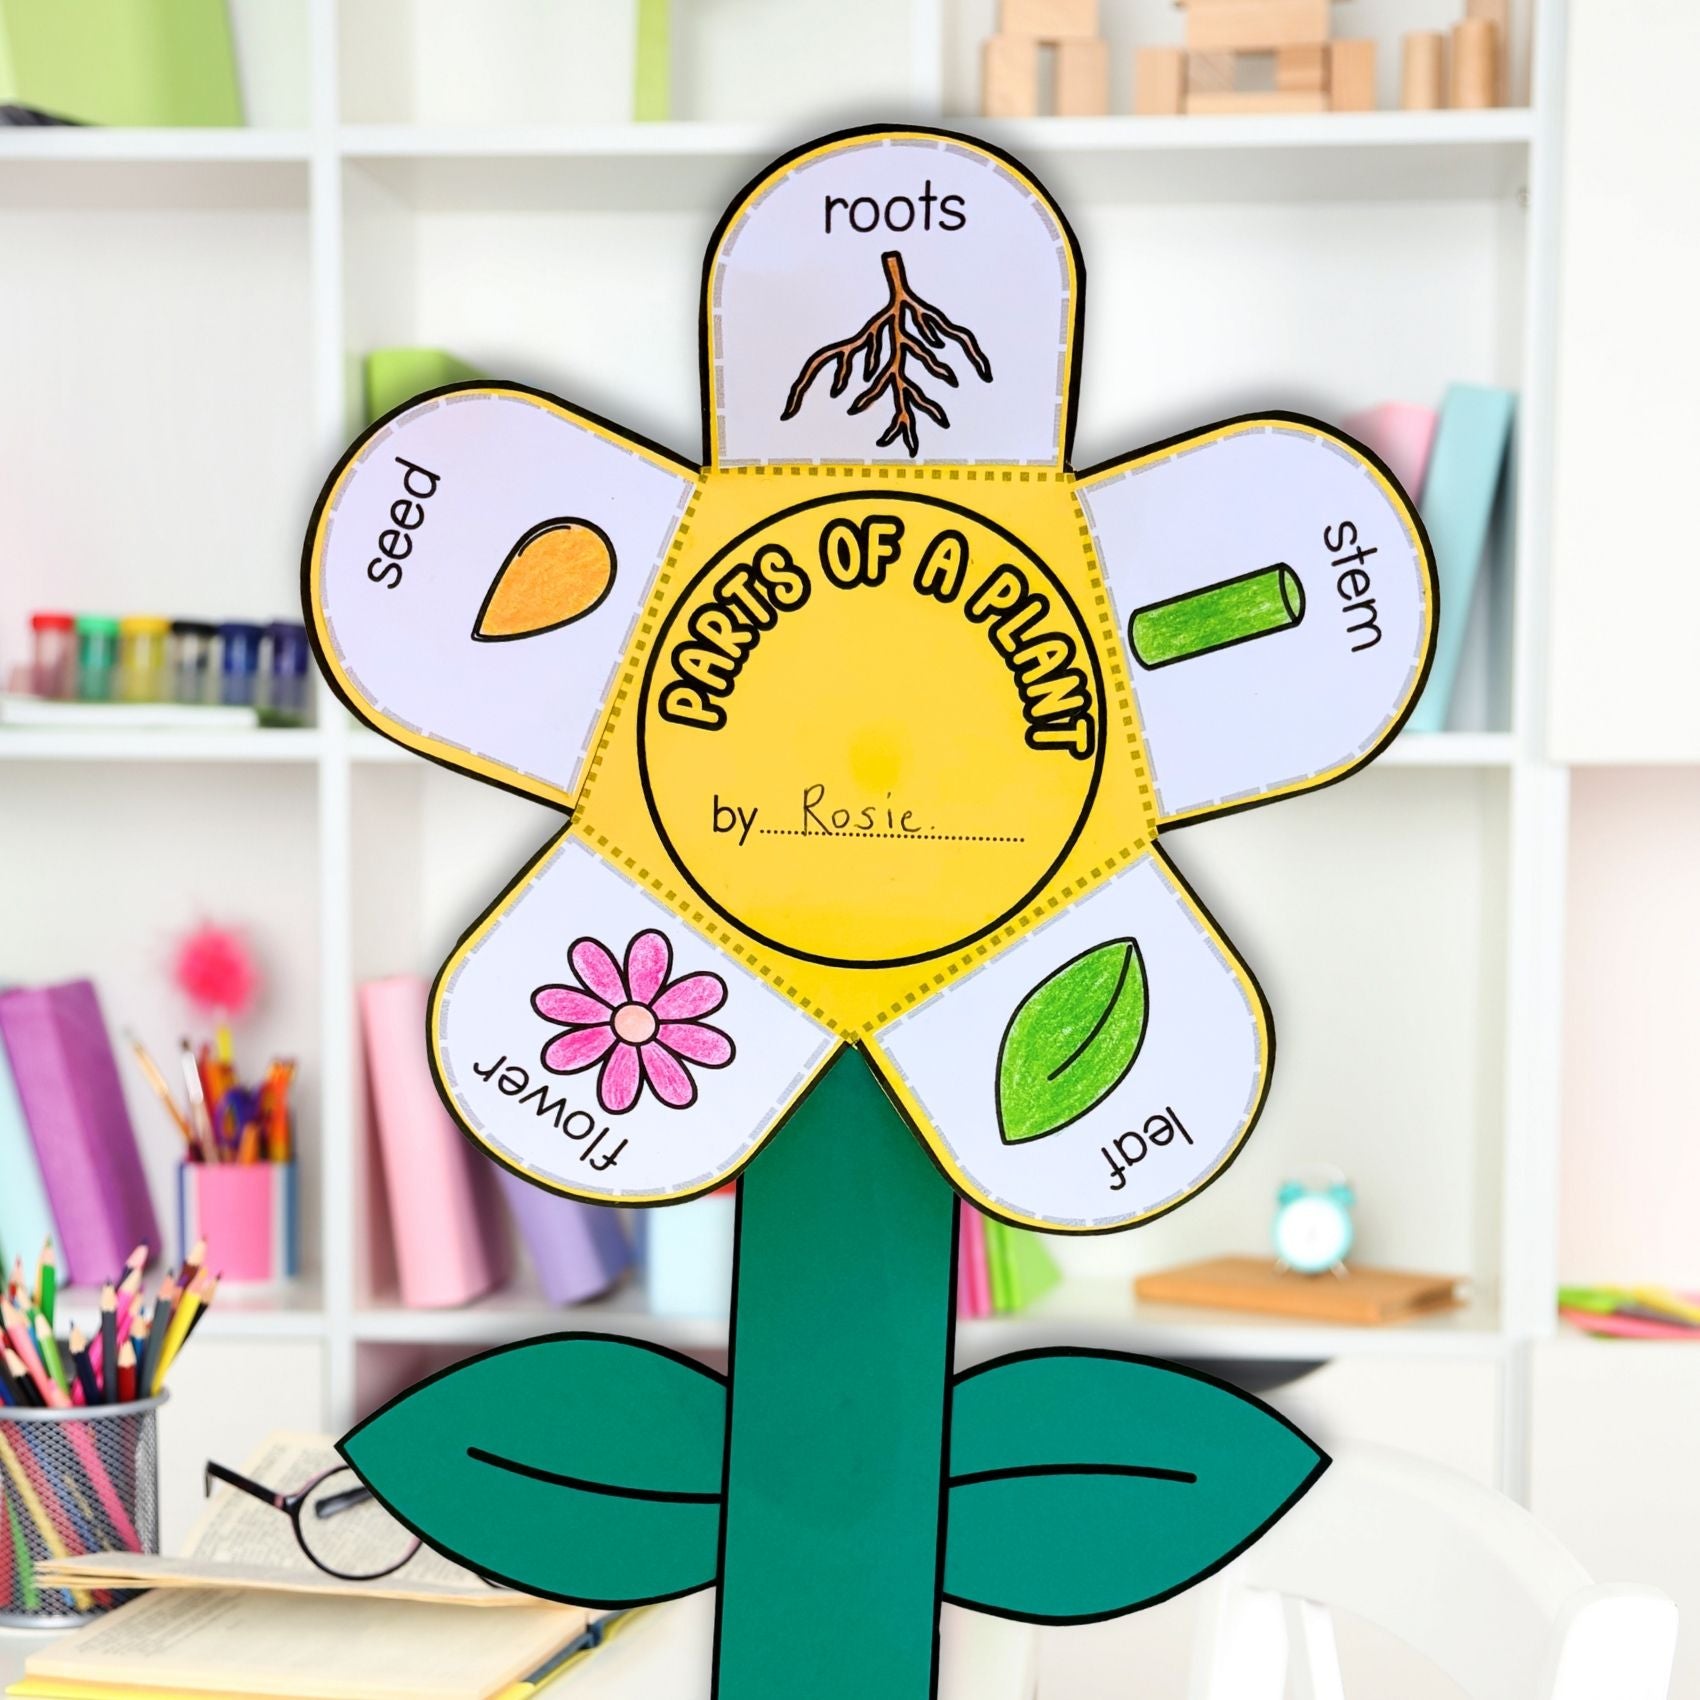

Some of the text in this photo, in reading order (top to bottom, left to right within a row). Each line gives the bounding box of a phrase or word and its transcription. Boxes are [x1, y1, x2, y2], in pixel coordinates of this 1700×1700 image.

[825, 179, 967, 234] roots
[367, 456, 441, 590] seed
[658, 514, 1096, 761] PARTS OF A PLANT
[1323, 520, 1383, 653] stem
[712, 794, 759, 847] by
[473, 1055, 629, 1172] flower
[1101, 1106, 1194, 1191] leaf
